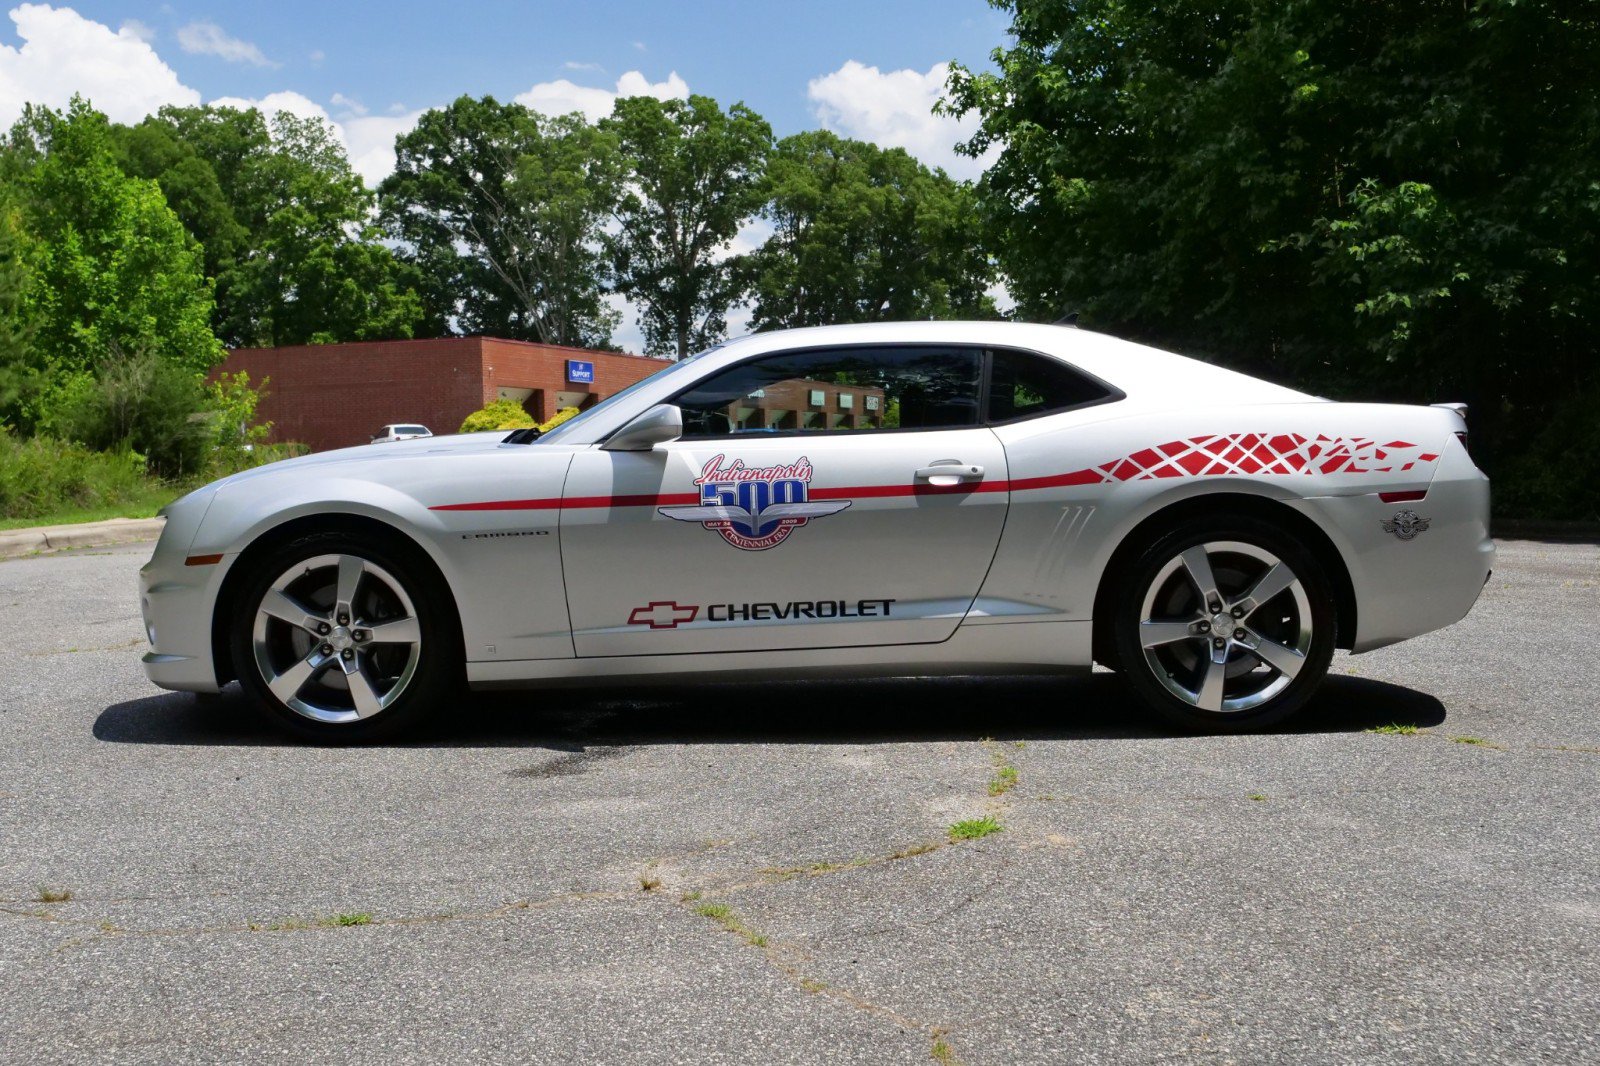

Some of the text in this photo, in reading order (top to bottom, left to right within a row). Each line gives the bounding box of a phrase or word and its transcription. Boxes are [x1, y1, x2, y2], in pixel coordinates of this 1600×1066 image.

[694, 454, 812, 484] Indianapolis
[699, 481, 808, 512] 500
[725, 528, 788, 548] CENTENNIAL ERA
[707, 598, 897, 622] CHEVROLET
